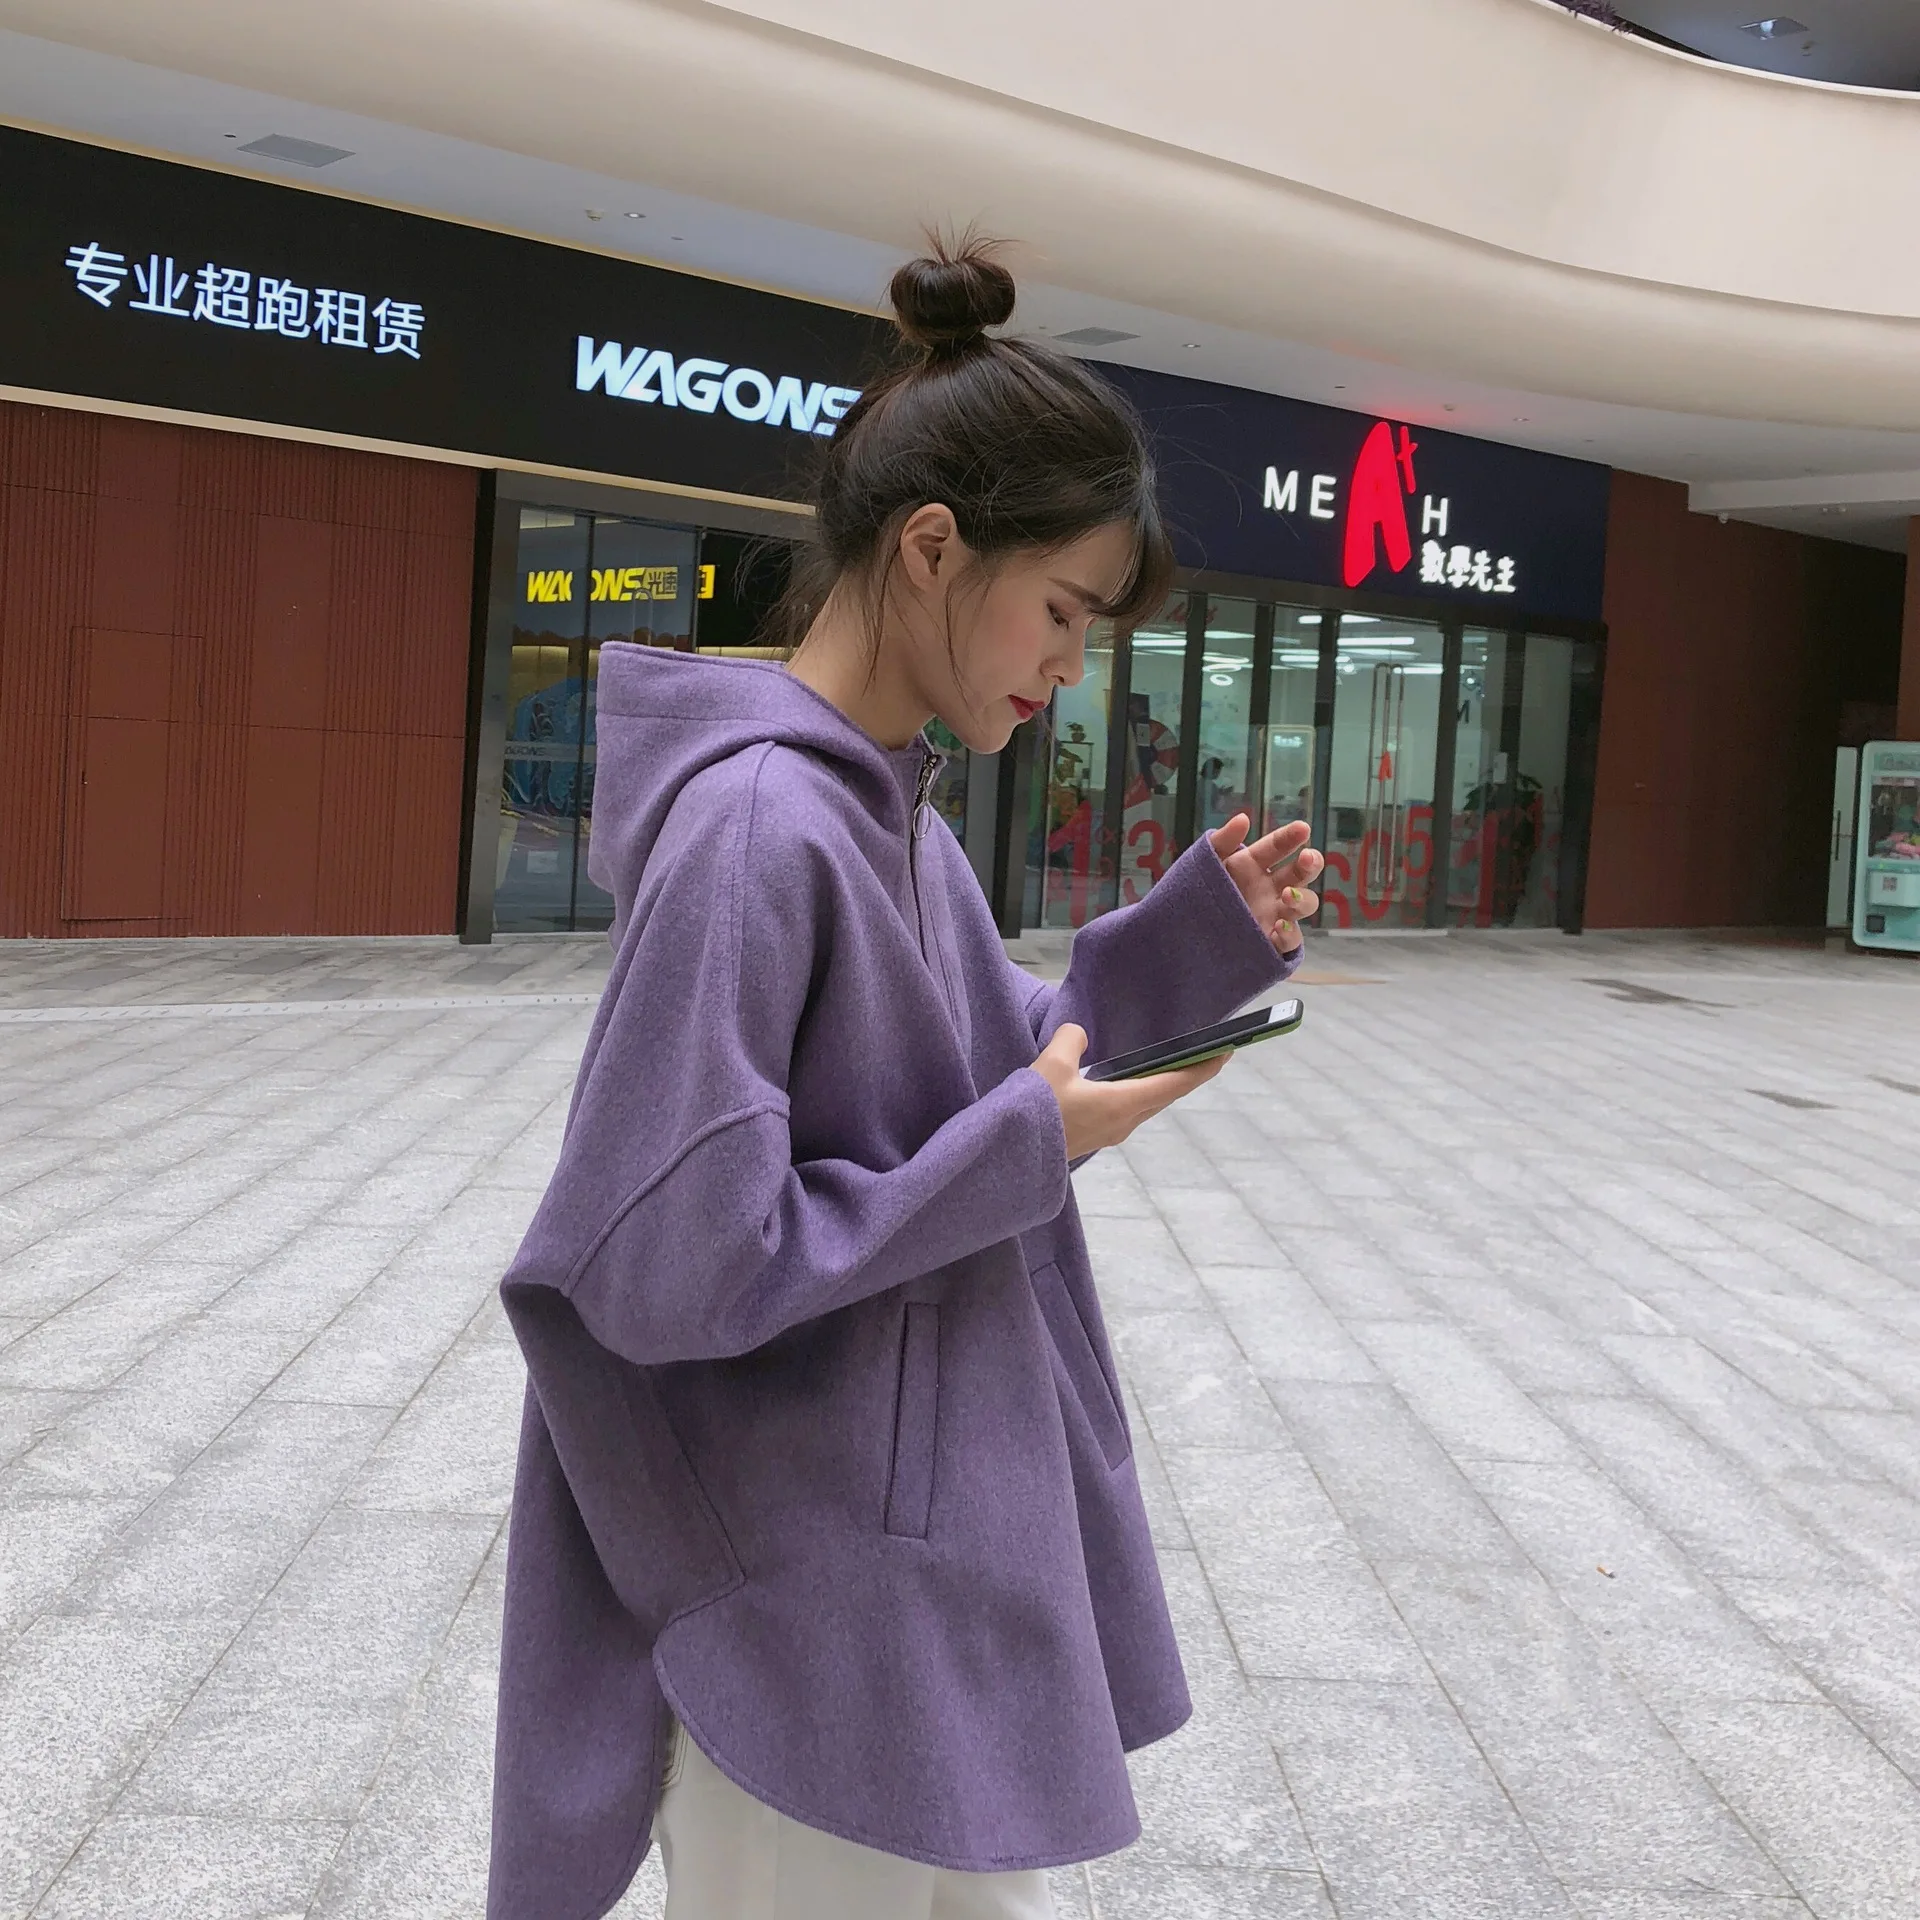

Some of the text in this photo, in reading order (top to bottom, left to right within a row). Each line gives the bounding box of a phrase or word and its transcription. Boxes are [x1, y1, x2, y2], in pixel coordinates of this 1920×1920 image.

[65, 241, 425, 360] 专业超跑租赁
[575, 335, 863, 437] WAGONS
